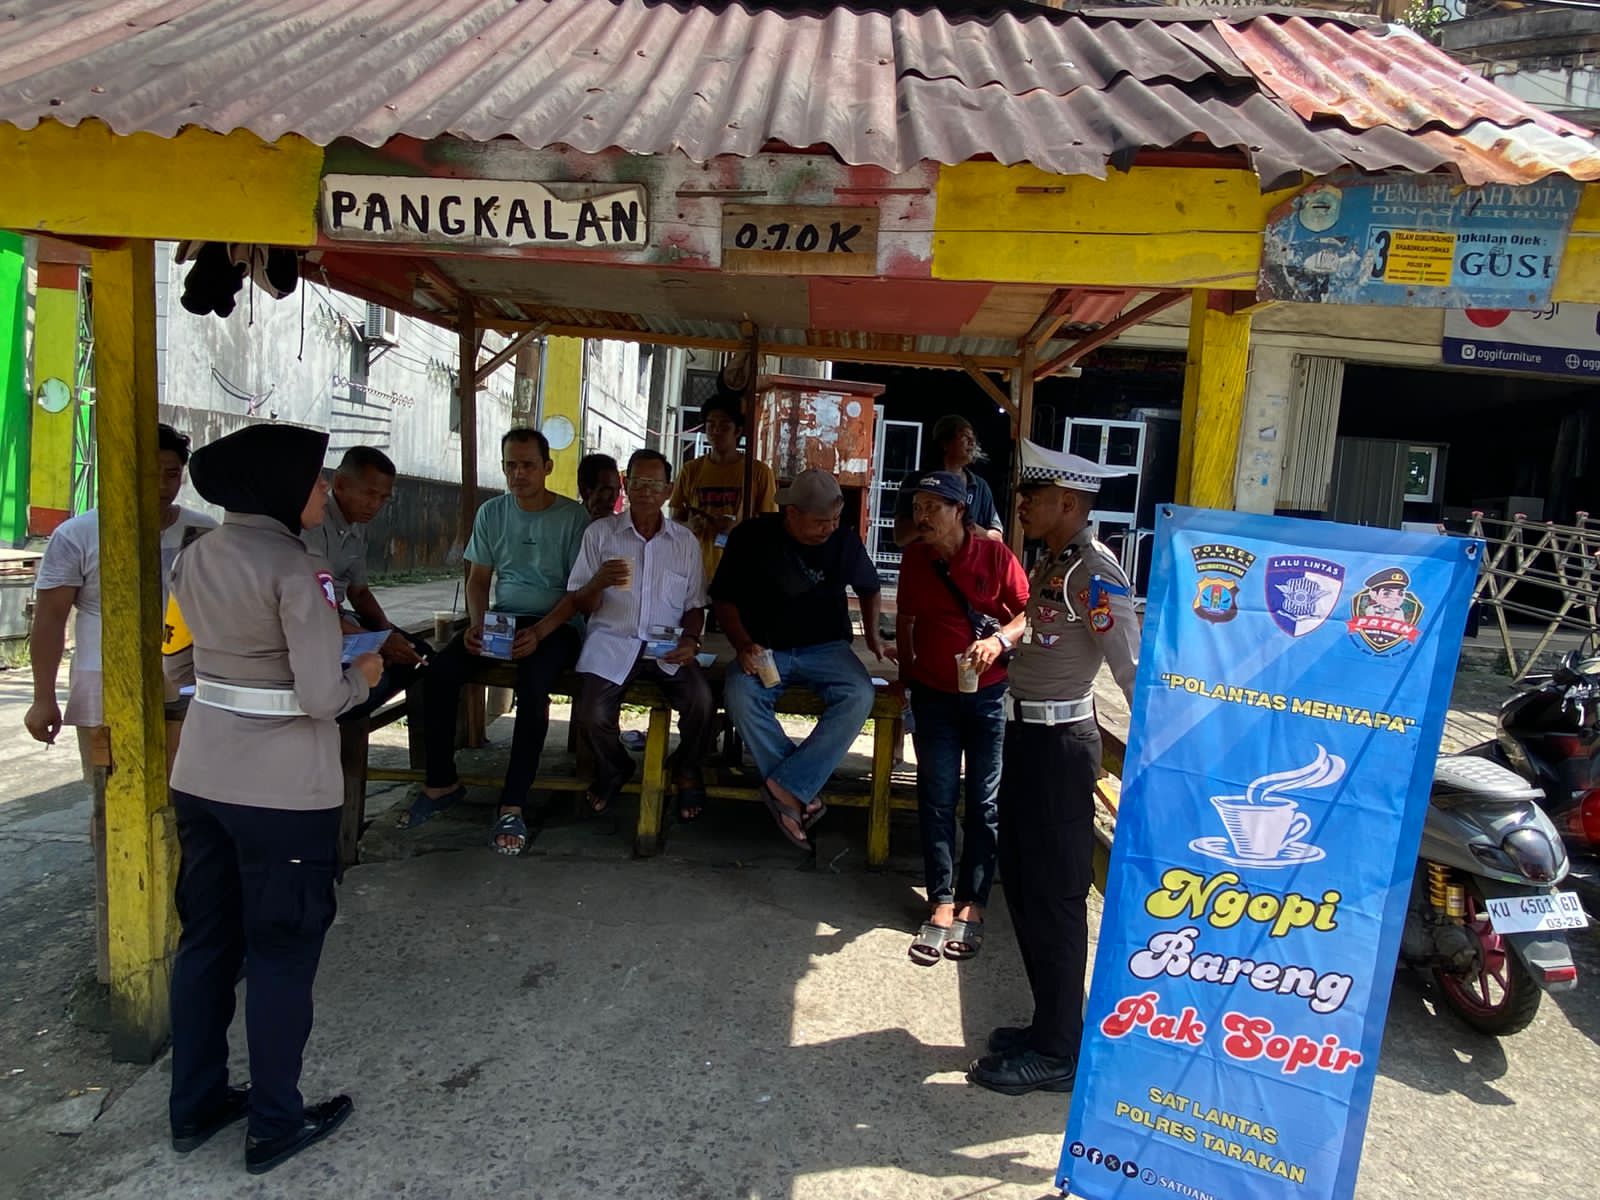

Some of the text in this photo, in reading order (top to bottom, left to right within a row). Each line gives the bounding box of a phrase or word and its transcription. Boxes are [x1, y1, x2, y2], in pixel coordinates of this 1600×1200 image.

[332, 190, 638, 242] PANGKALAN
[1477, 348, 1542, 363] oggifurniture
[1274, 559, 1339, 576] LALU LINTAS
[1356, 618, 1414, 634] PATEN
[1145, 867, 1342, 938] Ngopi
[1520, 898, 1555, 915] 4501
[1128, 926, 1353, 1014] Bareng
[1100, 991, 1363, 1074] Pak Sopir
[1115, 1101, 1306, 1184] POLRES TARAKAN
[1149, 1087, 1279, 1145] SAT LANTAS
